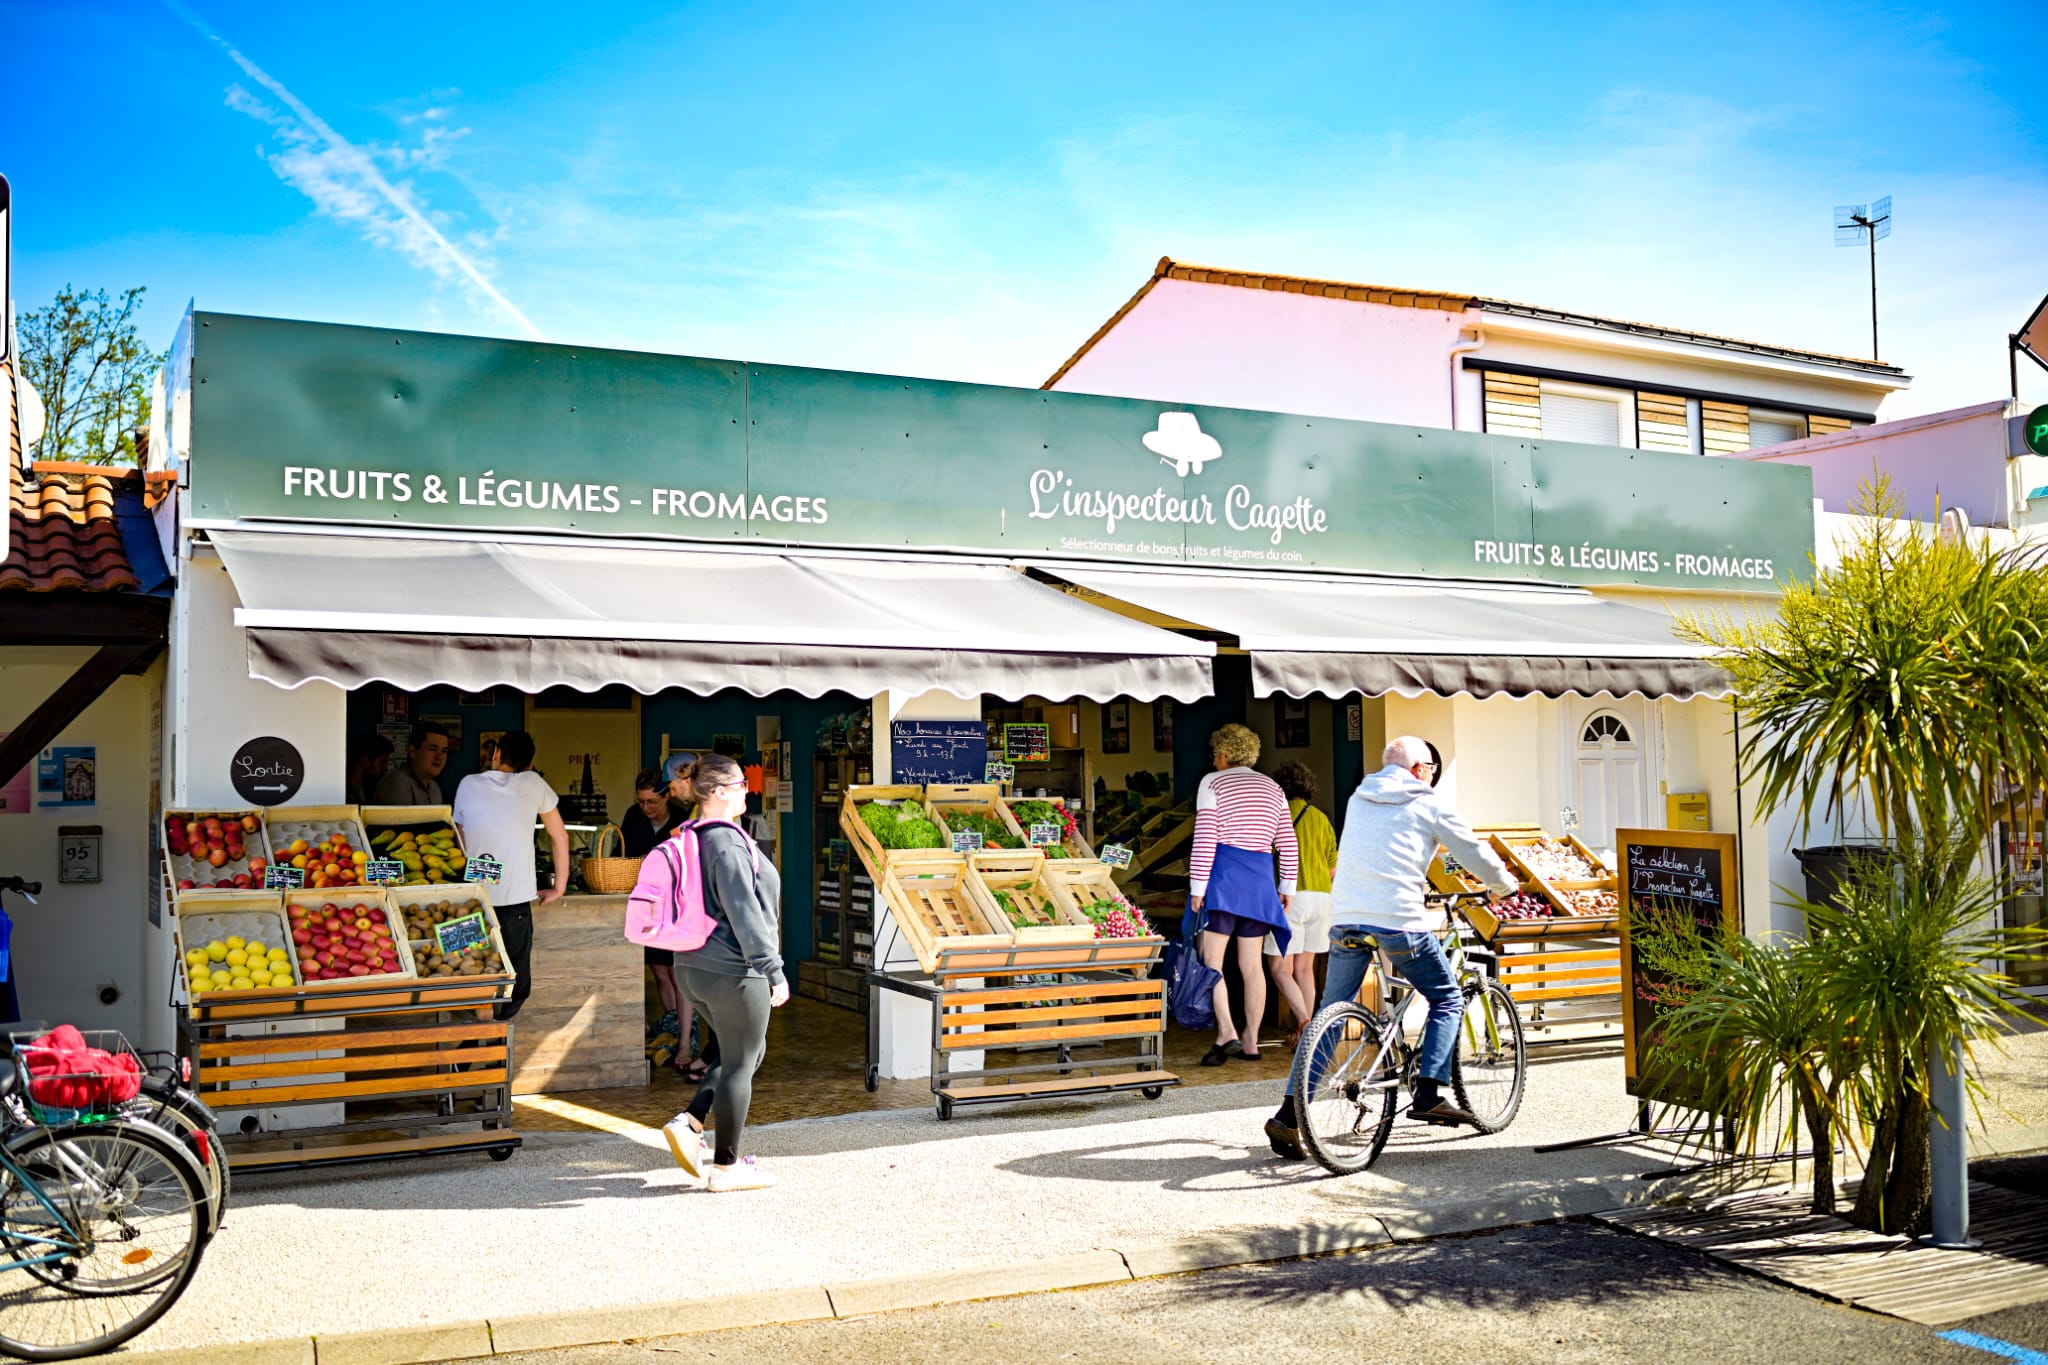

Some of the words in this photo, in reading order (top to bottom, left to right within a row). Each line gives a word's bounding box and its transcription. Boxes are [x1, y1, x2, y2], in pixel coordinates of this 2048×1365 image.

[283, 465, 411, 502] FRUITS
[422, 475, 449, 504] &
[459, 468, 621, 514] LÉGUMES
[651, 487, 828, 525] FROMAGES
[1028, 469, 1217, 534] L'inspecteur
[1225, 484, 1328, 544] Cagette
[1060, 536, 1134, 553] Sélectionneur
[1136, 540, 1151, 553] de
[1180, 544, 1209, 558] fruits
[1210, 546, 1221, 557] et
[1223, 545, 1265, 561] légumes
[1266, 548, 1280, 559] du
[1281, 550, 1303, 561] coin
[1474, 540, 1544, 566] FRUITS
[1550, 548, 1565, 567] &
[1569, 542, 1659, 573] LÉGUMES
[1675, 553, 1774, 580] FROMAGES
[235, 756, 294, 778] Sortie
[568, 750, 601, 766] PRVÉ
[1630, 846, 1646, 866] La
[1694, 857, 1706, 877] de
